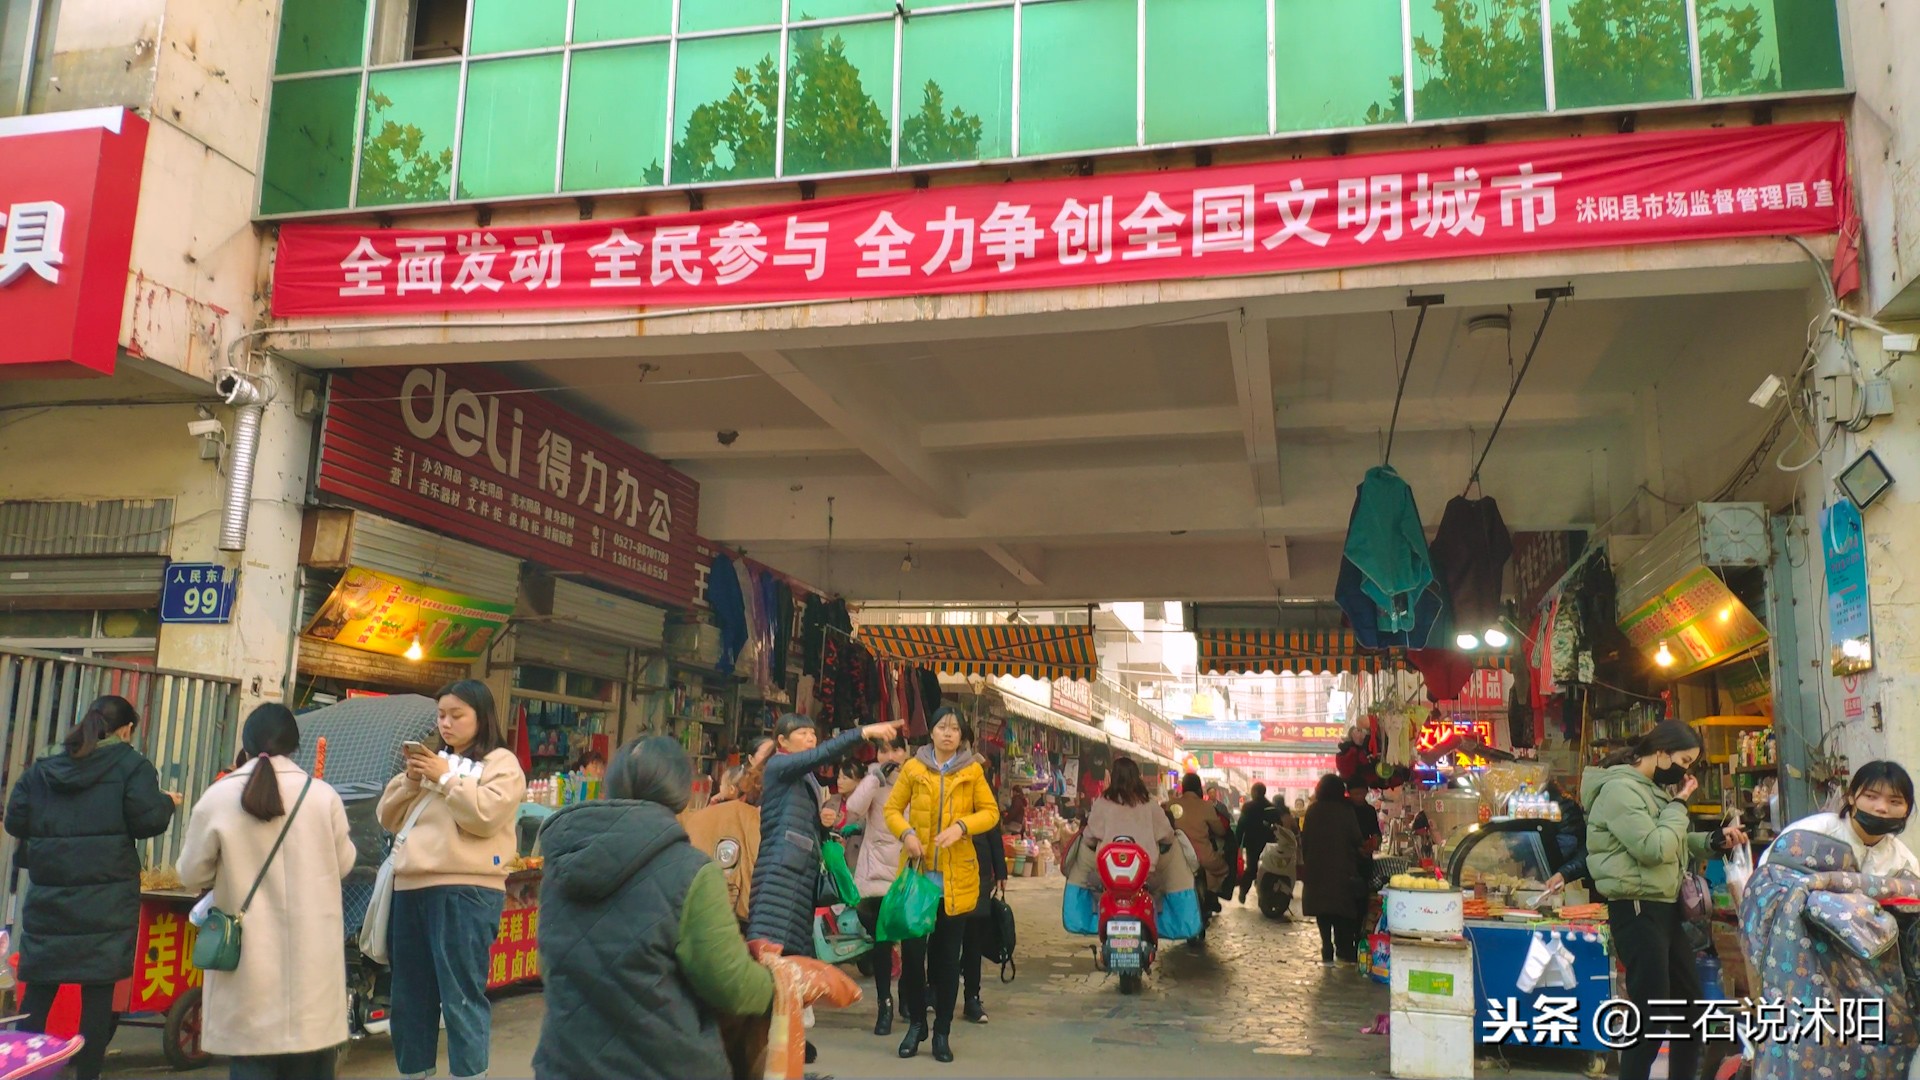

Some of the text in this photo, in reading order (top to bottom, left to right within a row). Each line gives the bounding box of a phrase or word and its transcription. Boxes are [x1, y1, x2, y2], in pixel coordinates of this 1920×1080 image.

[1576, 179, 1834, 222] 沐阳县市场监督管理局 宣
[0, 200, 65, 288] 具
[338, 162, 1563, 297] 全面发动 全民参与 全力争创全国文明城市
[389, 446, 404, 485] 主营
[422, 457, 462, 485] 办公用品
[469, 476, 504, 500] 学生用品
[536, 428, 672, 542] 得力办公
[418, 478, 461, 507] 音乐器材
[466, 496, 502, 522] 文件柜
[173, 569, 234, 586] 人民东
[183, 587, 218, 615] 99
[1462, 668, 1502, 699] 用品
